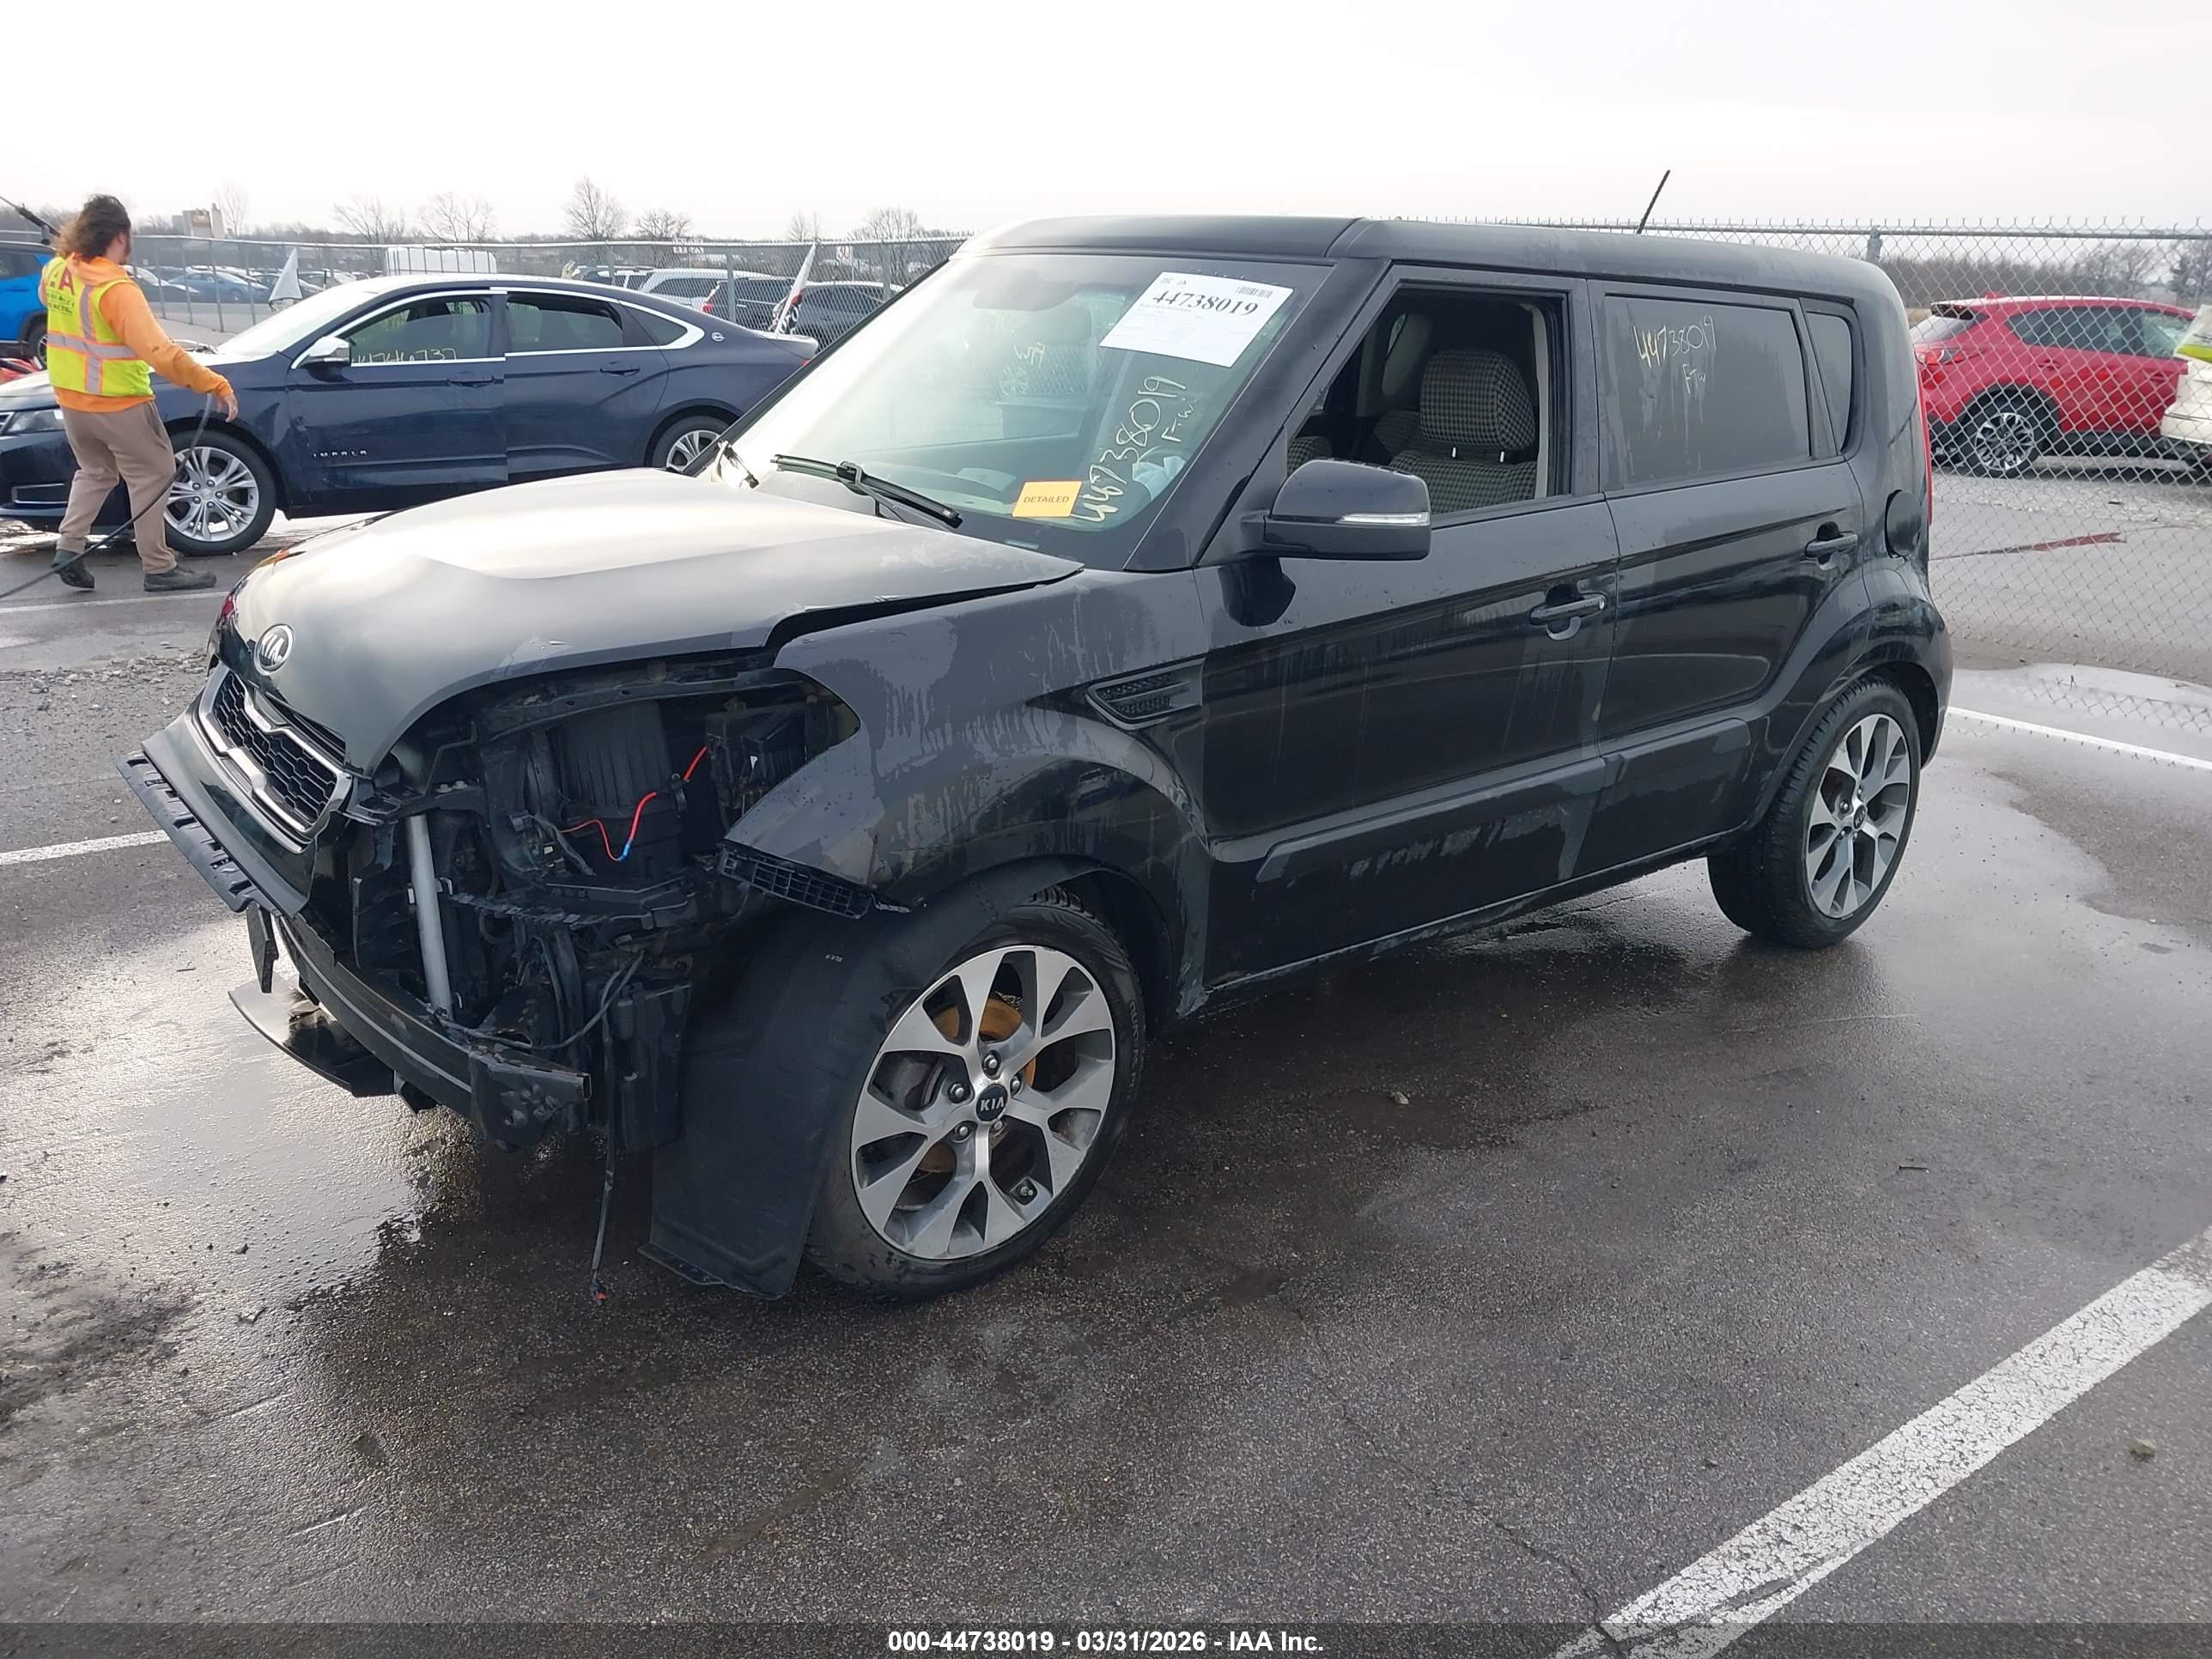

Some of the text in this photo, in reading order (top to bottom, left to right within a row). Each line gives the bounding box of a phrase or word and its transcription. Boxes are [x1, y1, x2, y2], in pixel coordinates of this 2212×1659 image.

[1152, 289, 1259, 316] 44738019
[1633, 315, 1717, 368] 44738019
[1070, 376, 1186, 522] 44738019
[1023, 495, 1069, 504] DETAILED
[258, 631, 285, 662] KIA
[980, 1096, 1005, 1112] KIA
